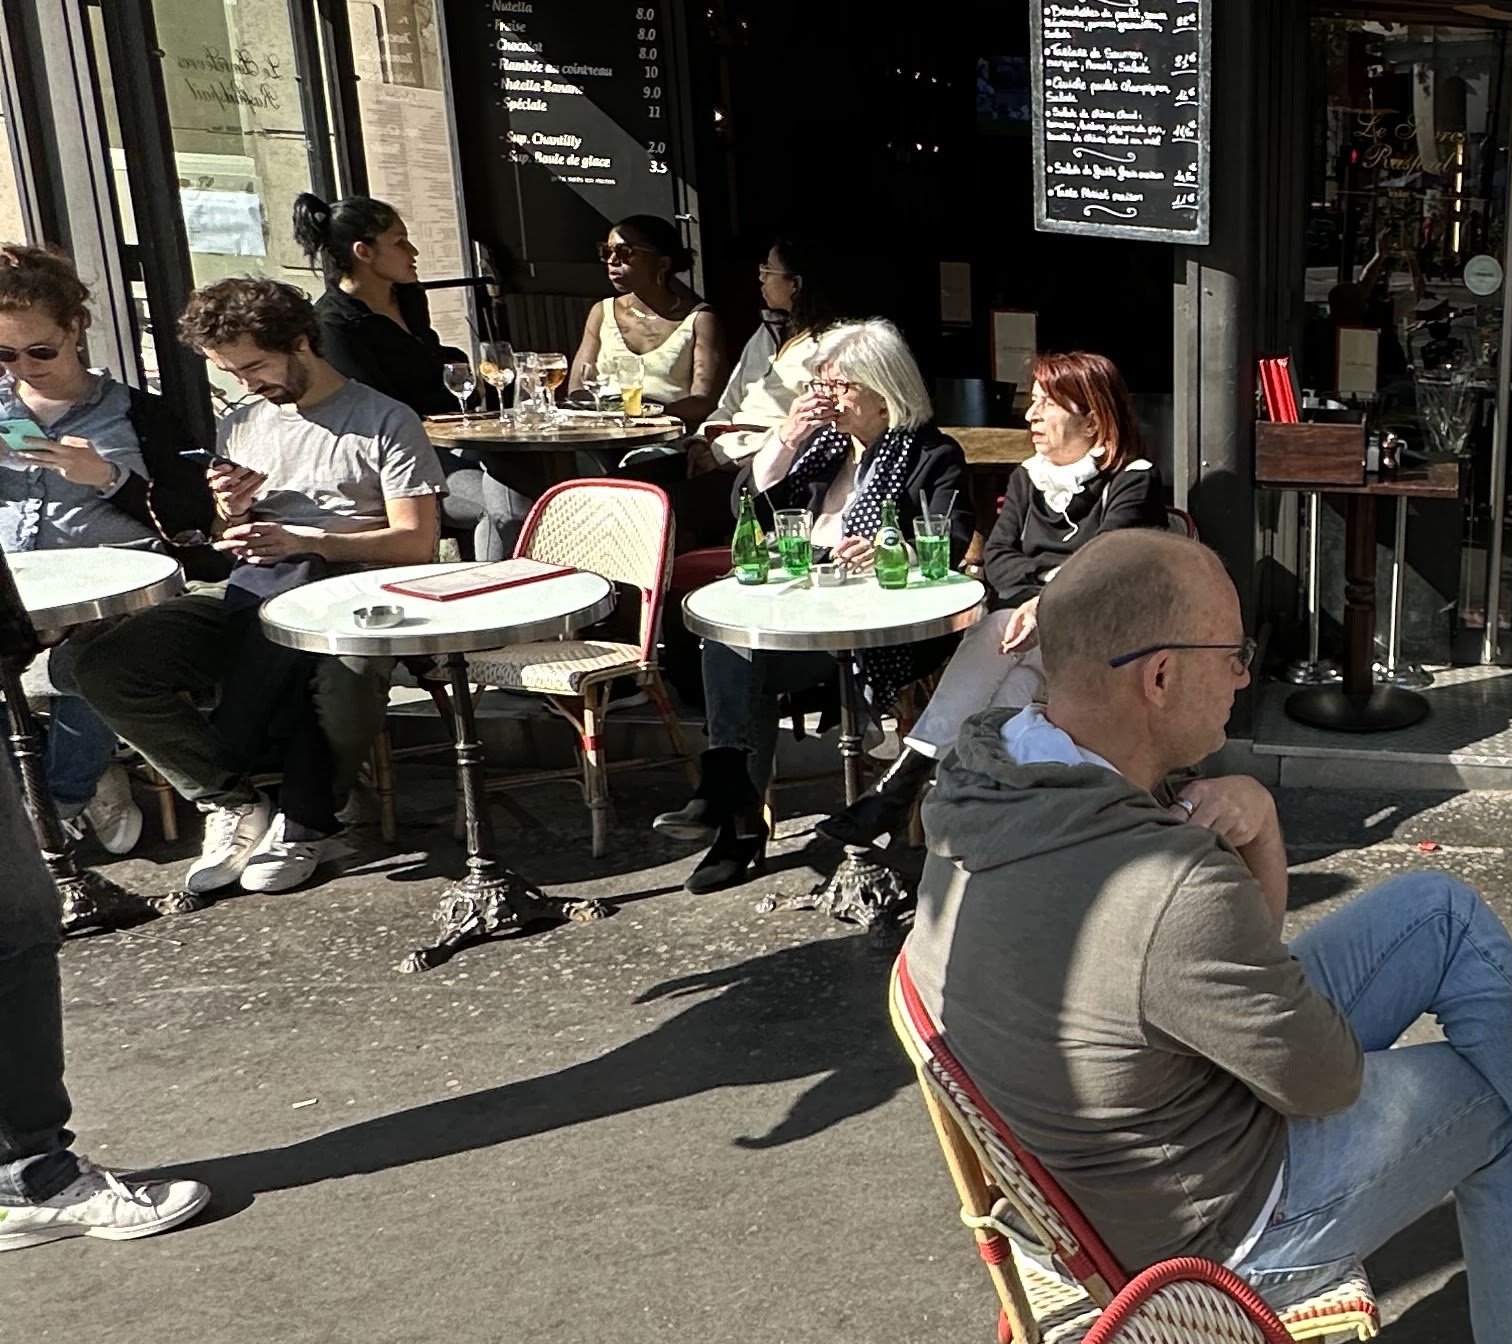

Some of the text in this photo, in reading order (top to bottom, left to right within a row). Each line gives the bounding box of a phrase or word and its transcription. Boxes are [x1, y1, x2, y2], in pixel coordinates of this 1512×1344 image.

[492, 0, 655, 21] Nutella 8.0
[494, 18, 656, 41] Fraise 8.0
[496, 38, 658, 61] Chocolat 8.0
[499, 58, 543, 73] Flambée
[645, 66, 658, 78] 10
[501, 78, 661, 99] Nutella-Banane 9.0
[503, 97, 661, 118] Spéciale 11
[506, 131, 666, 154] Sup. Chantilly 2.0
[534, 151, 565, 166] Boule
[566, 154, 580, 166] de
[581, 155, 611, 169] glace
[649, 160, 669, 174] 3.5
